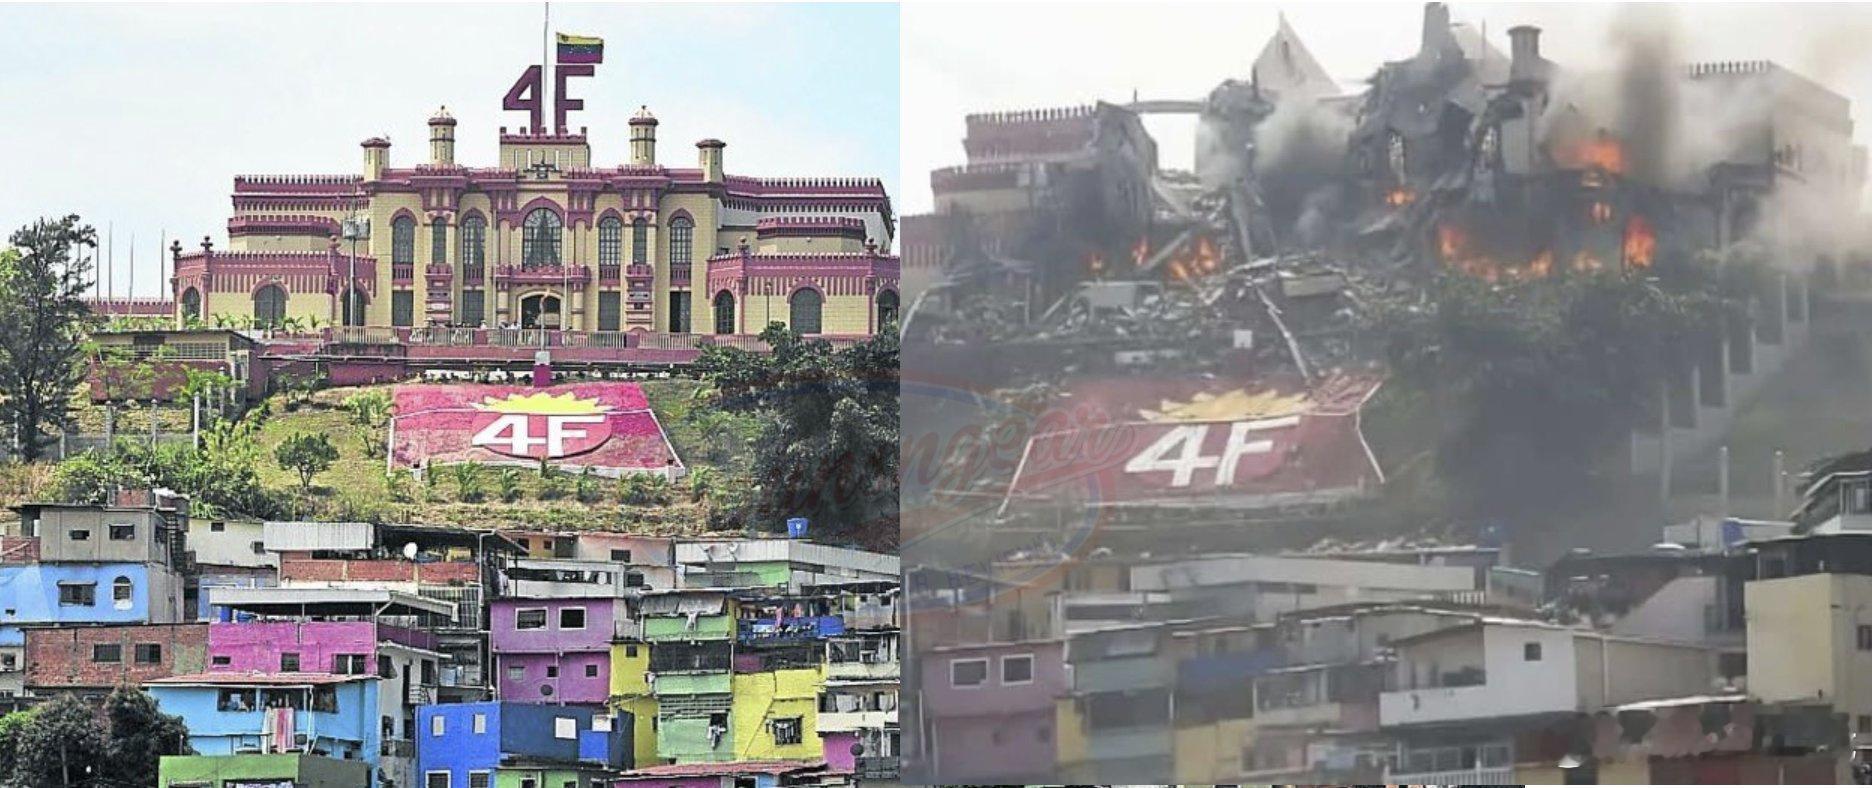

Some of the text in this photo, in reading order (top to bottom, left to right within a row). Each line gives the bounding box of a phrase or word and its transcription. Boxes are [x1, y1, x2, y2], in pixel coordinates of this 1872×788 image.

[503, 65, 595, 137] 4F
[471, 414, 608, 457] 4F
[1124, 414, 1302, 488] 4F
